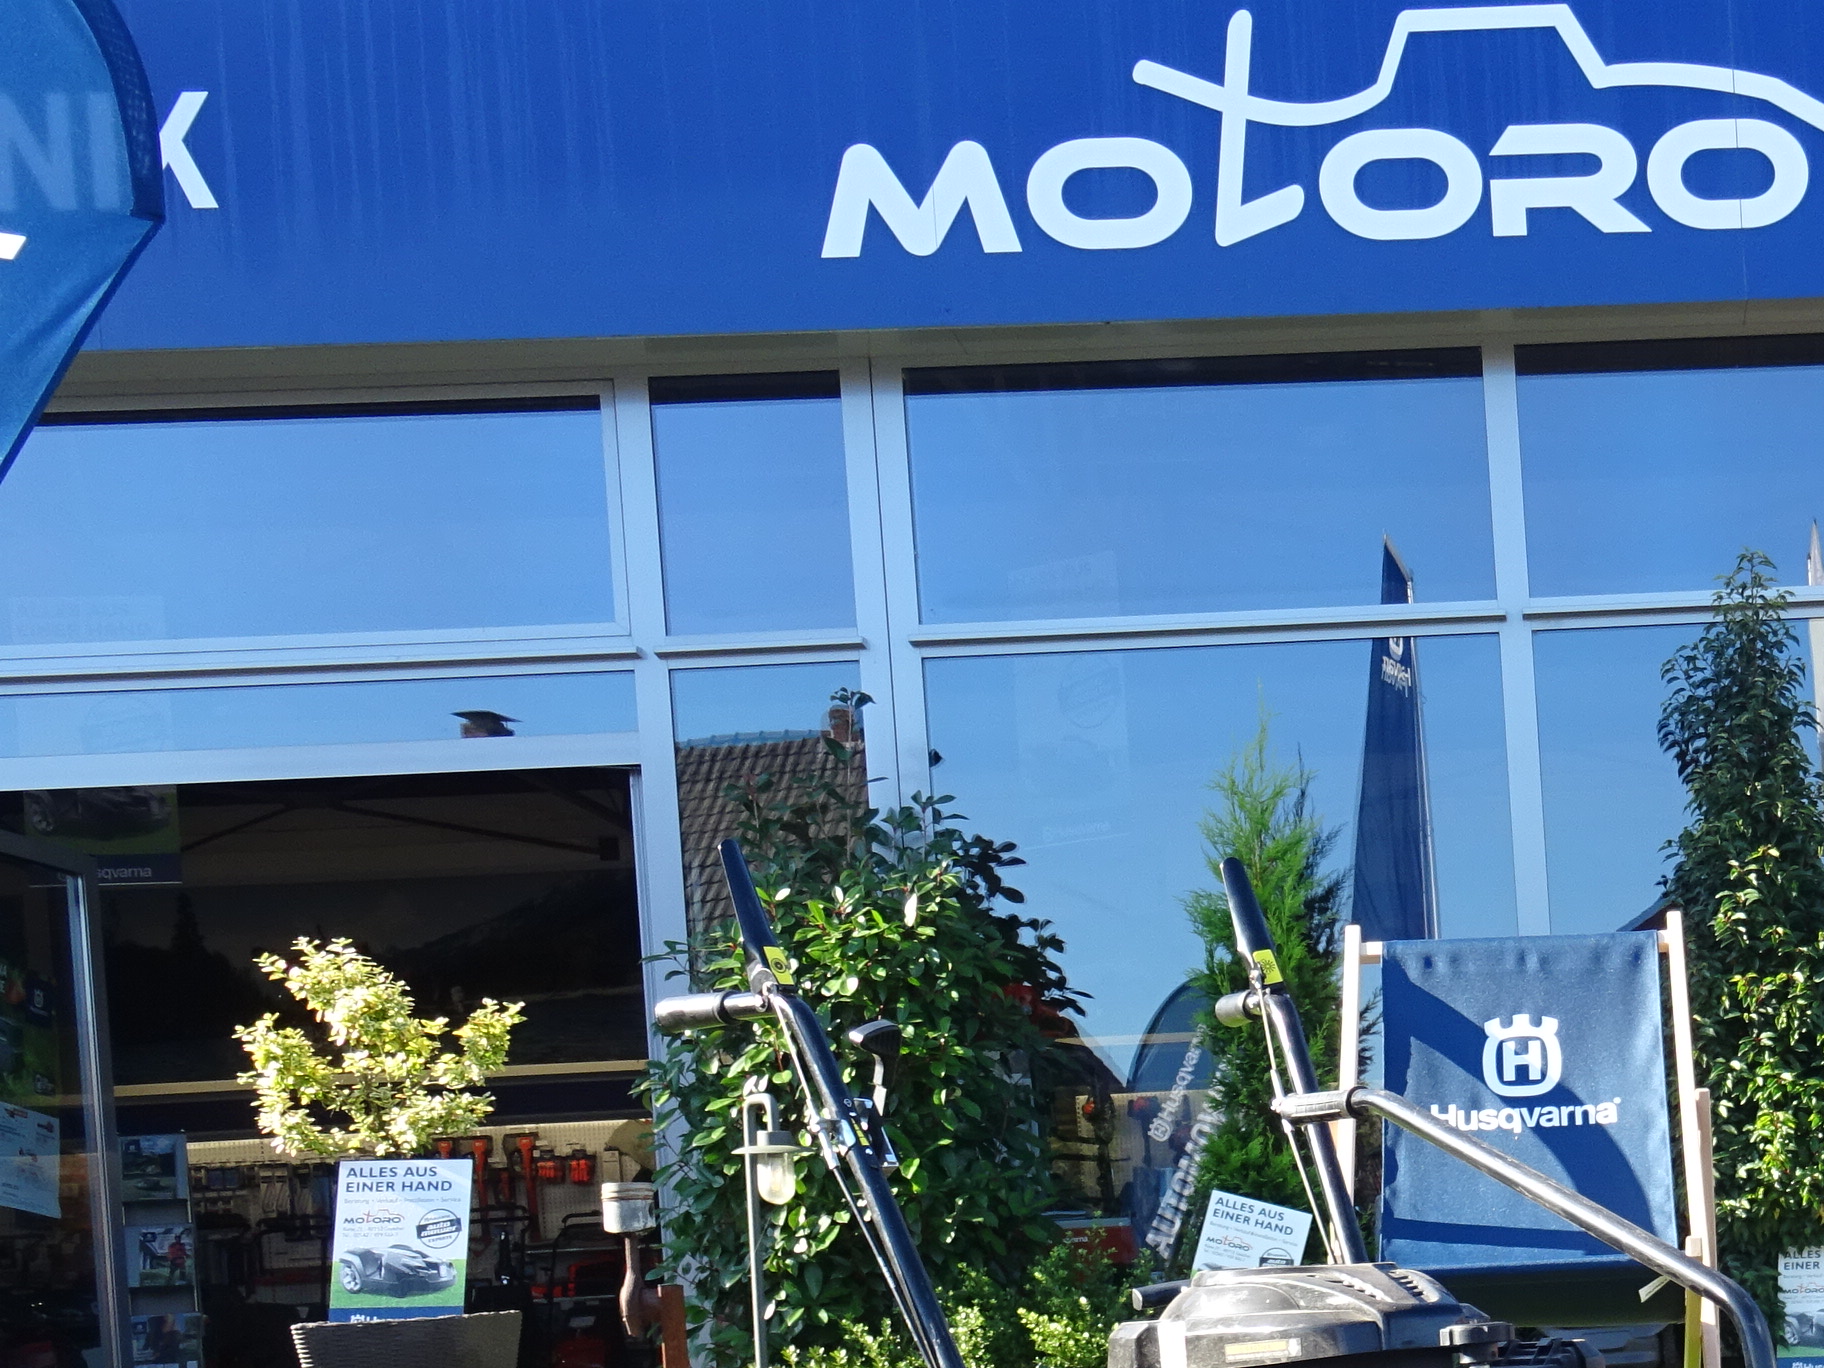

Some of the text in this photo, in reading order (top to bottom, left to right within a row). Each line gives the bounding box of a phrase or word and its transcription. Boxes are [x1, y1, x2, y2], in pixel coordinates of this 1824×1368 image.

[1430, 1100, 1619, 1134] Husqvarna
[346, 1166, 438, 1179] ALLES AUS
[345, 1180, 453, 1193] EINER HAND
[1215, 1196, 1286, 1222] ALLES AUS
[1212, 1208, 1251, 1226] EINER
[1254, 1218, 1294, 1236] HAND
[1783, 1249, 1822, 1260] ALLES
[1783, 1260, 1821, 1271] EINER
